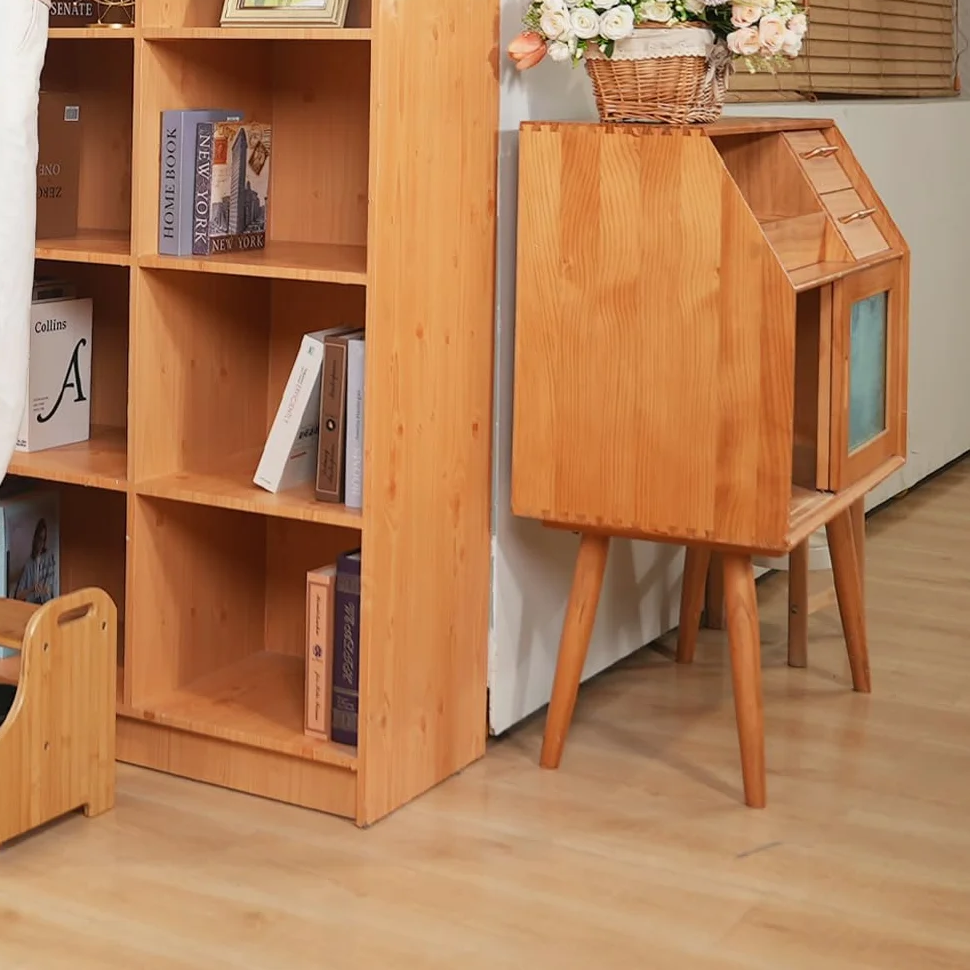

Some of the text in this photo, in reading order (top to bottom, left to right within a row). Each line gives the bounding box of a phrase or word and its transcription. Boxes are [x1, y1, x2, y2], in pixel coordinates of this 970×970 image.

[50, 1, 93, 16] SENATE
[163, 128, 177, 239] HOME BOOK
[194, 134, 211, 244] NEW YORK
[212, 235, 264, 252] NEW YORK
[34, 319, 67, 334] Collins
[36, 338, 87, 423] A
